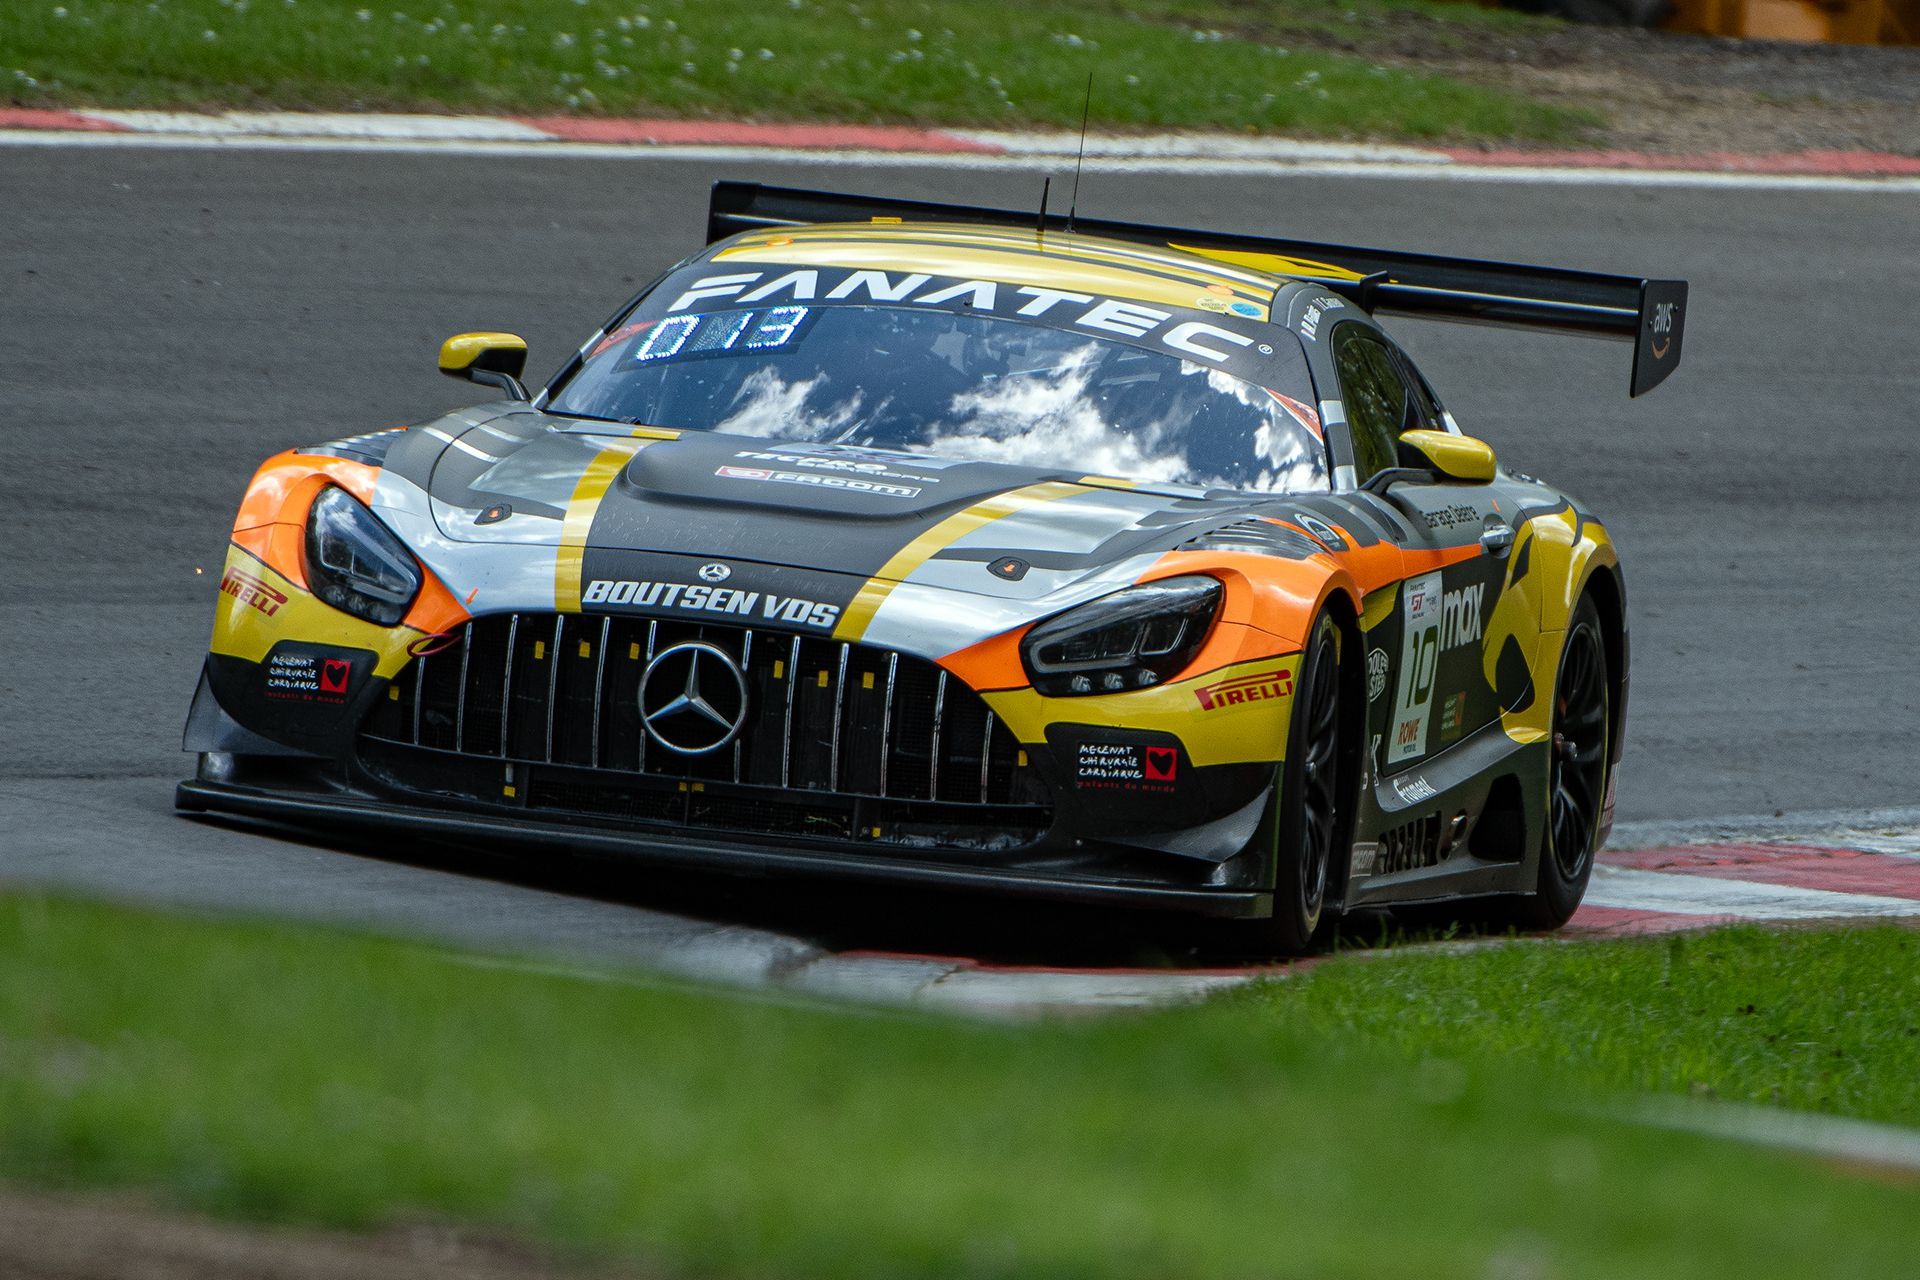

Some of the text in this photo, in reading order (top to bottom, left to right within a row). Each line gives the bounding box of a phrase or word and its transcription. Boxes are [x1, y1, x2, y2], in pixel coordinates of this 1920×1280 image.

[668, 269, 1255, 362] FANATEC
[1653, 302, 1673, 334] aws
[774, 472, 913, 497] FACOM
[220, 566, 289, 617] PIRELLI
[581, 580, 841, 629] BOUTSEN VDS
[1440, 581, 1485, 652] max
[1193, 668, 1294, 712] PIRELLI
[1405, 624, 1438, 709] 10
